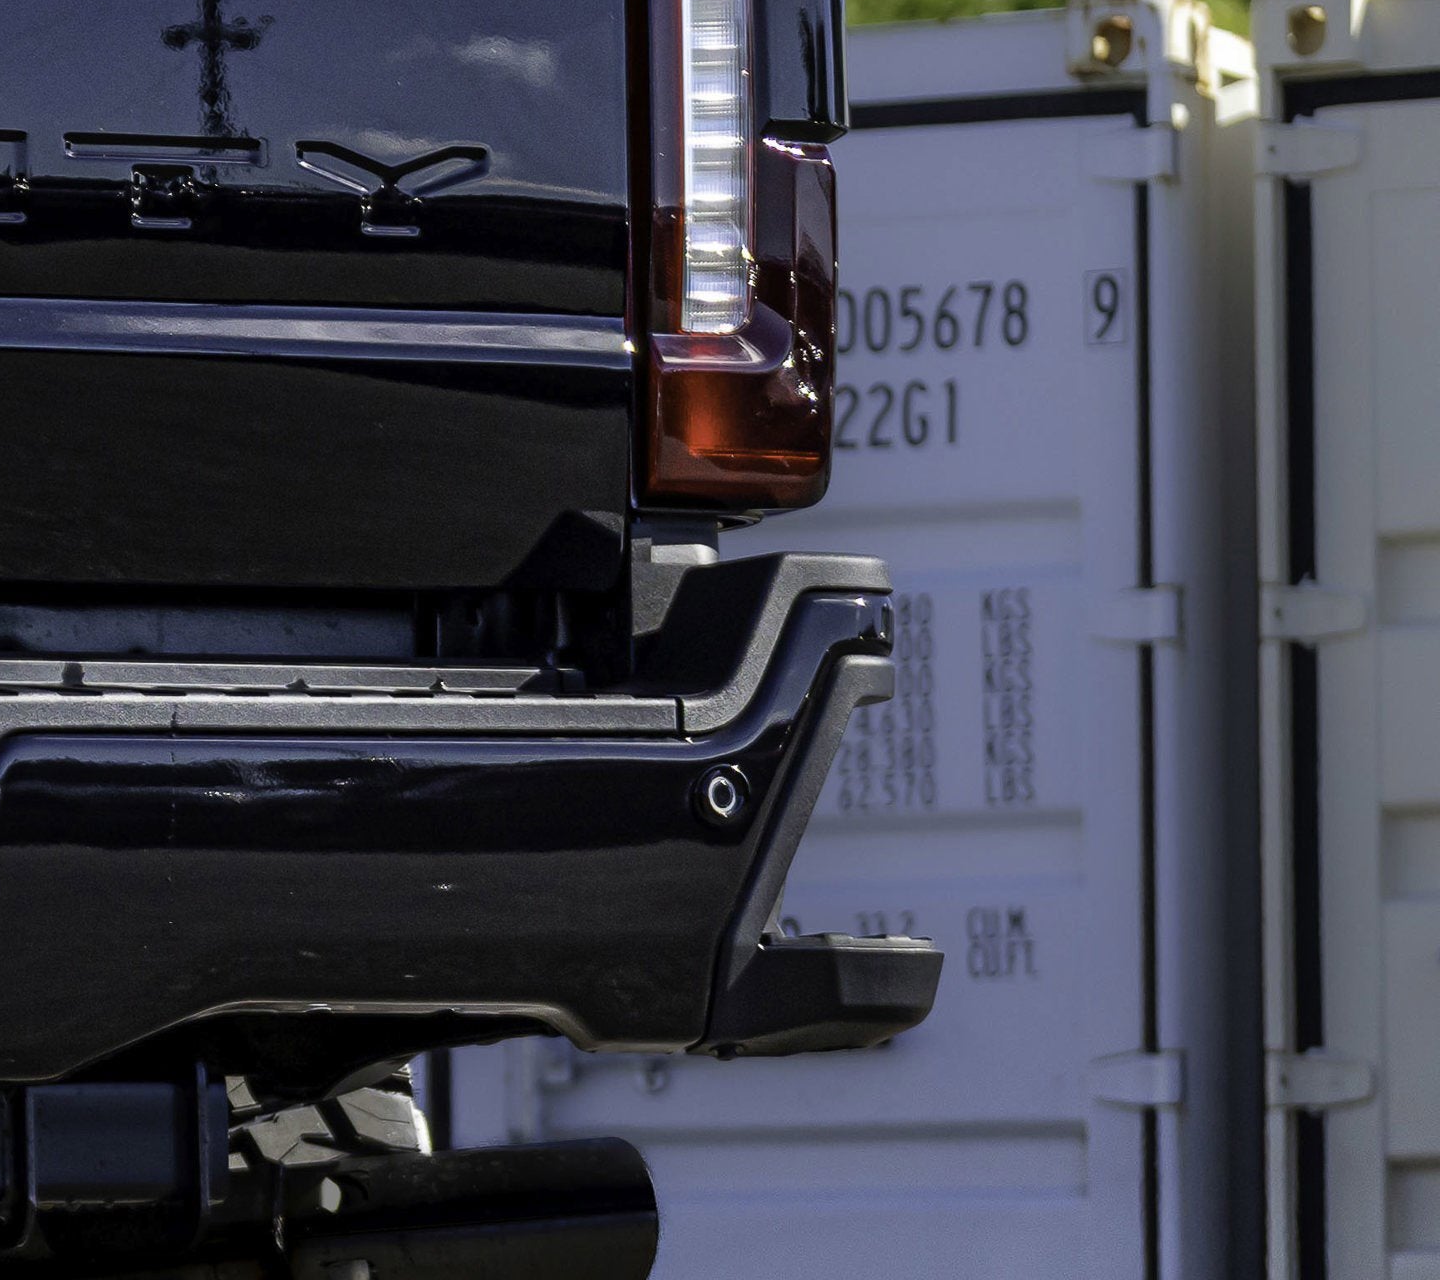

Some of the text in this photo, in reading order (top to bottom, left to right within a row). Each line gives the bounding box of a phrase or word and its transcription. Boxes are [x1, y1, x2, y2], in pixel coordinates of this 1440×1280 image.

[836, 273, 1120, 355] 005678 9
[833, 378, 958, 450] 22G1
[982, 622, 1033, 657] LBS
[983, 694, 1034, 730] LBS
[985, 766, 1035, 804] LBS
